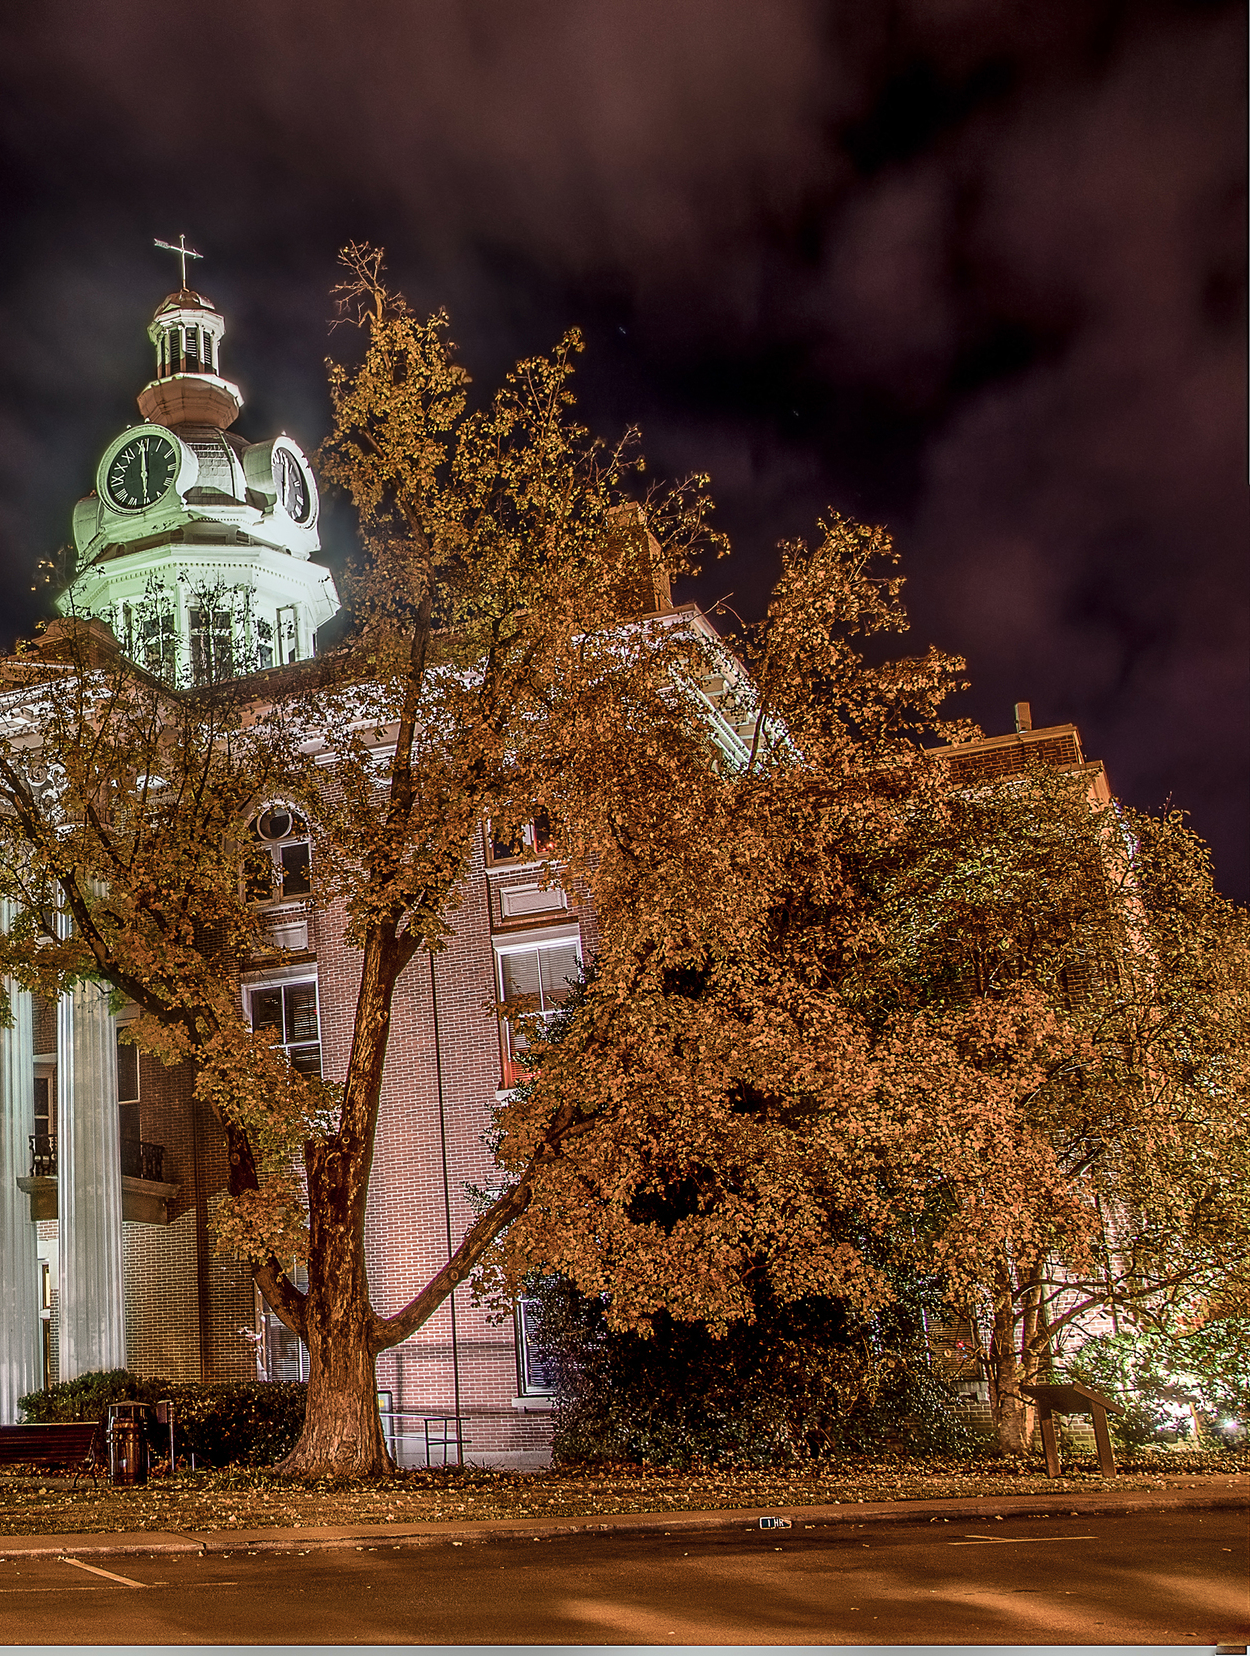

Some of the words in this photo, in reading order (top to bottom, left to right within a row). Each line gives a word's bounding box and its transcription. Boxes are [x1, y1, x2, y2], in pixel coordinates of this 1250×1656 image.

[121, 447, 136, 464] XI
[114, 462, 128, 473] X
[111, 474, 125, 487] IX
[774, 1518, 785, 1527] HR
